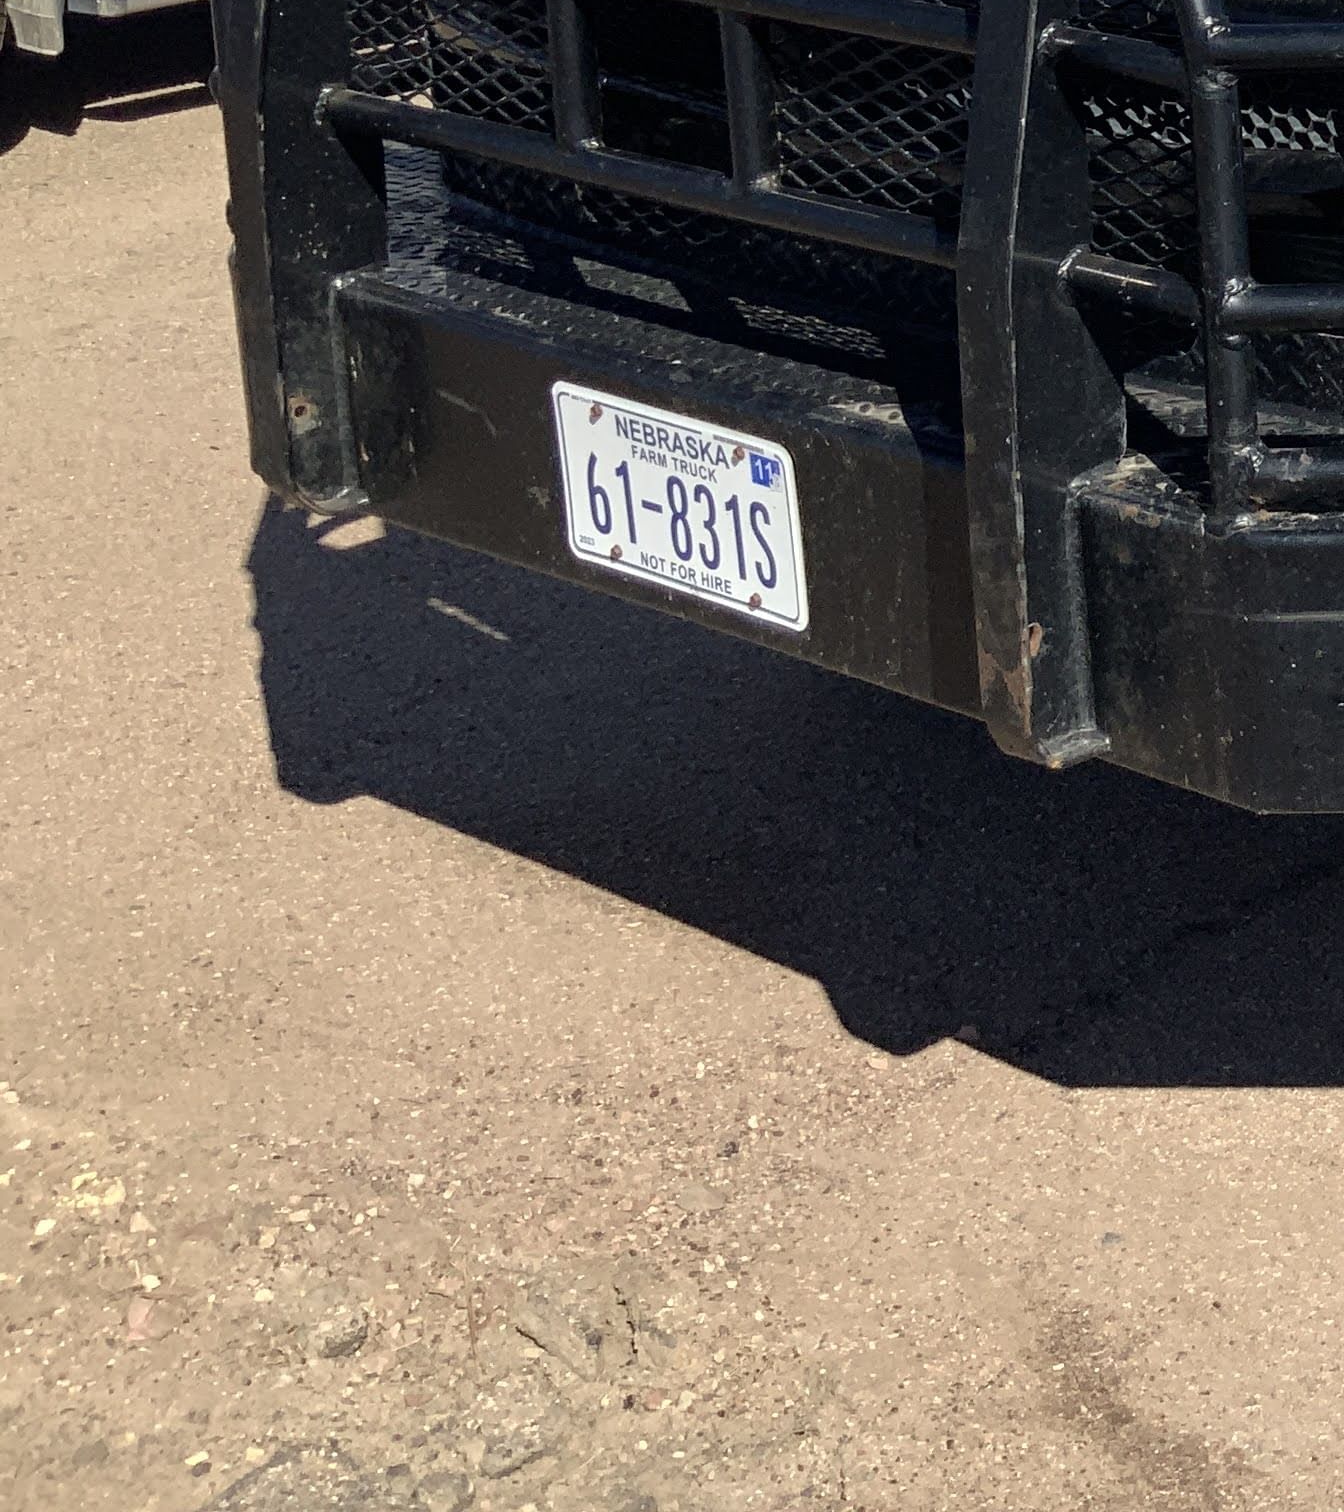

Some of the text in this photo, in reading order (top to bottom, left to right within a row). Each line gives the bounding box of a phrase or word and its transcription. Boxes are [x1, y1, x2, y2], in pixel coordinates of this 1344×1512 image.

[614, 414, 730, 469] NEBRASKA
[631, 444, 718, 484] FARM TRUCK
[587, 452, 778, 589] 61-831S
[640, 551, 732, 595] NOT FOR HIRE
